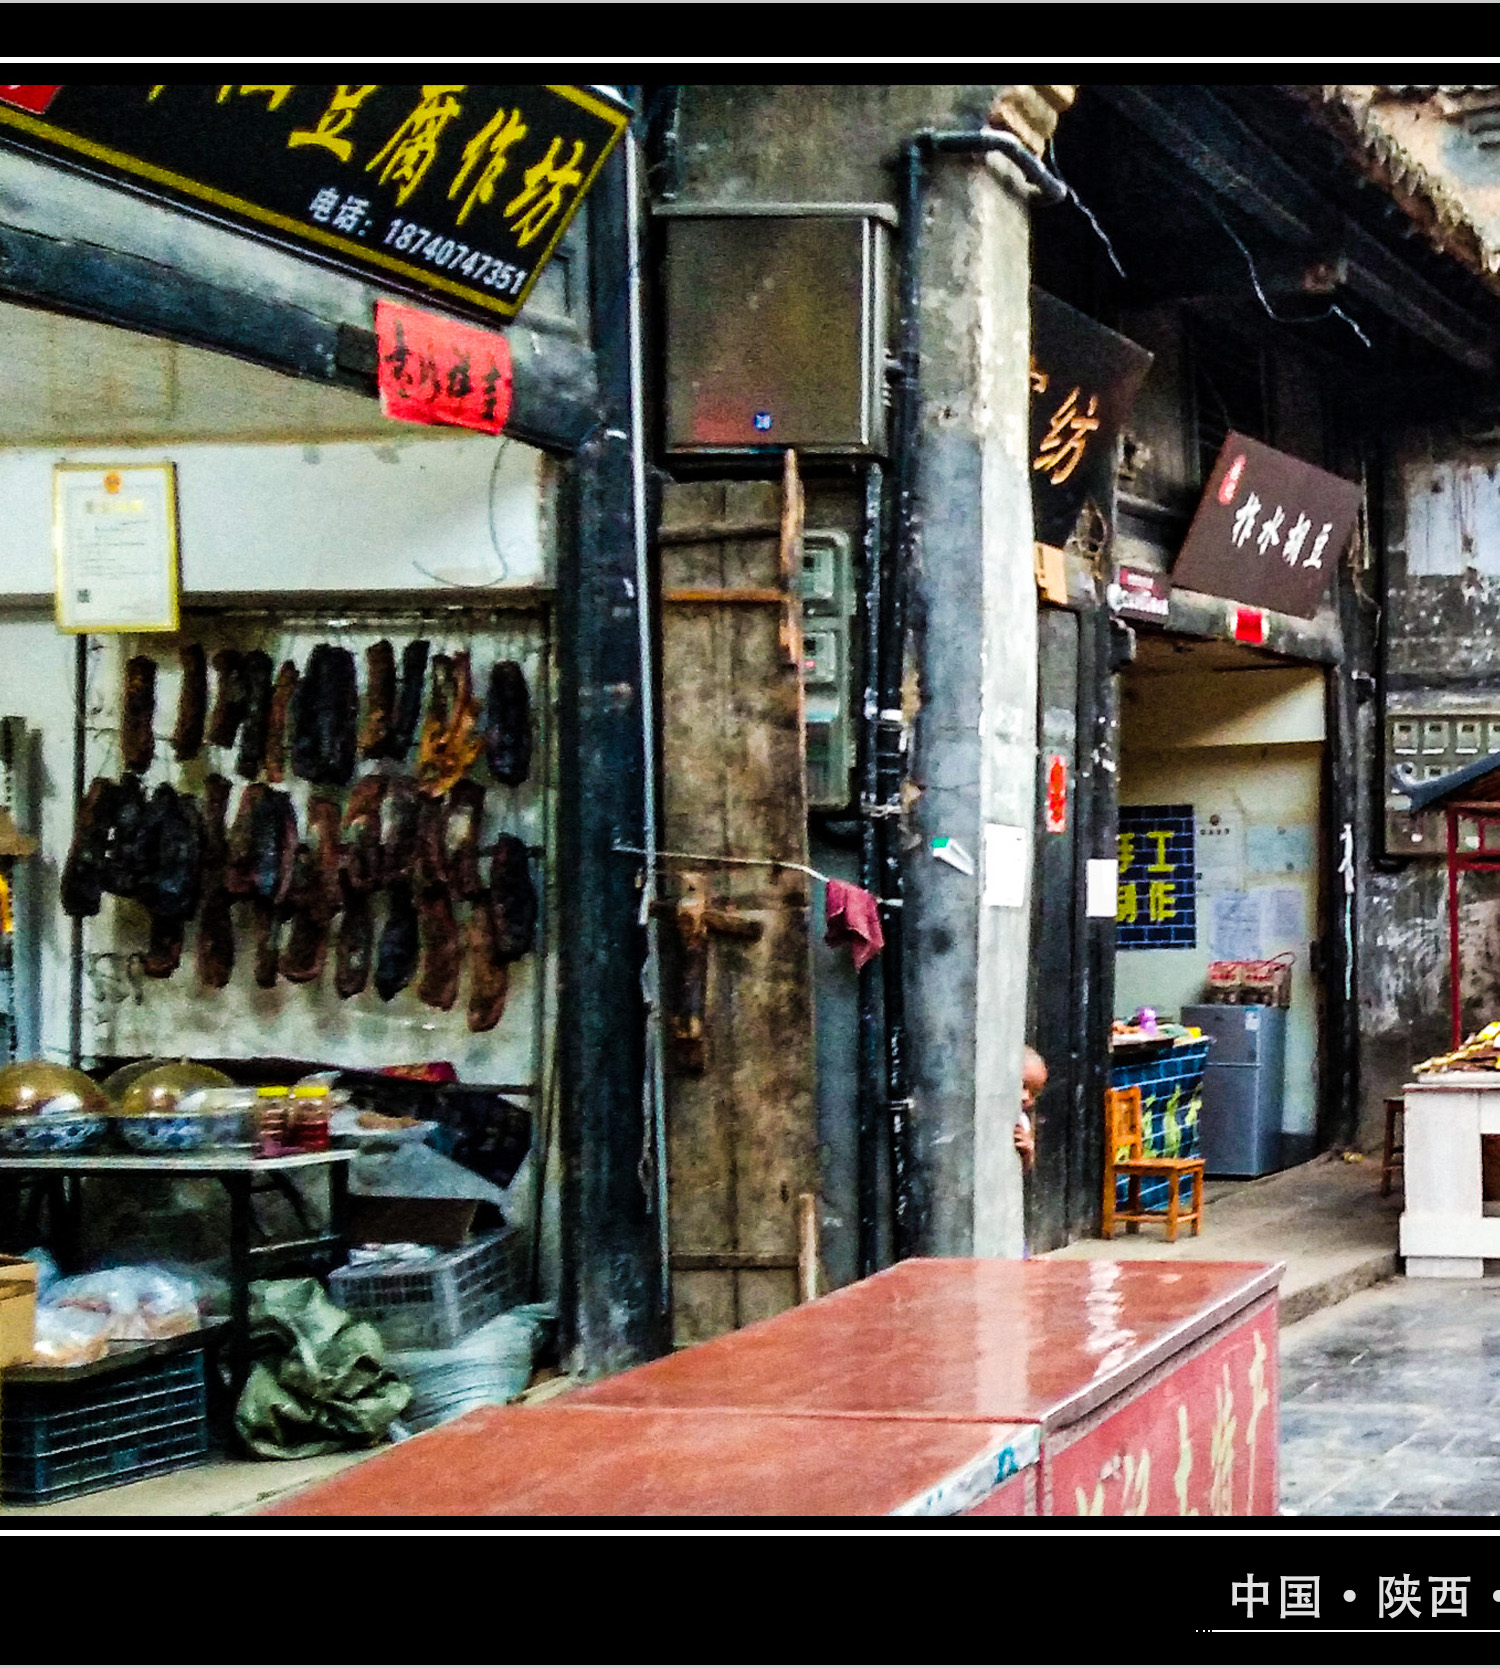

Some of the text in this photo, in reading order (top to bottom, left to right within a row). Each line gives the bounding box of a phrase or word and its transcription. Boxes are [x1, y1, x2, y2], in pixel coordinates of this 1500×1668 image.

[148, 85, 589, 247] 豆腐作坊
[382, 218, 527, 295] 18740747351
